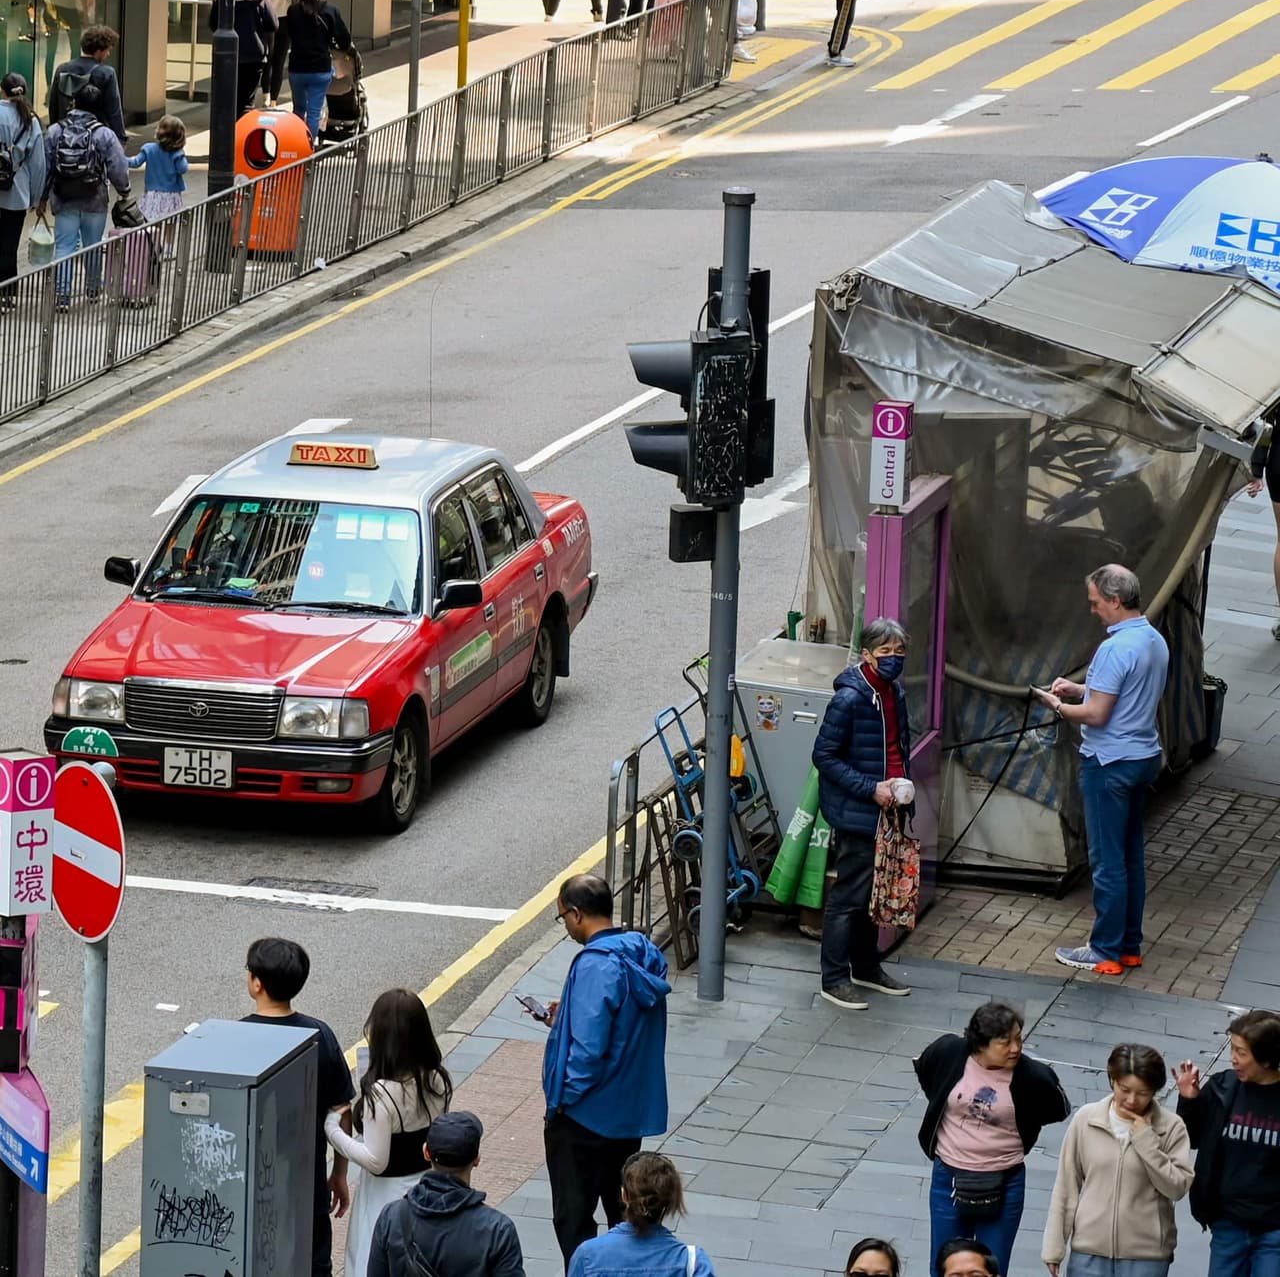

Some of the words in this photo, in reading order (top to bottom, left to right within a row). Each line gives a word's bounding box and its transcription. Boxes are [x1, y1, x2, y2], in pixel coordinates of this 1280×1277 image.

[297, 445, 367, 464] TAXI
[881, 445, 896, 499] Central
[73, 745, 107, 755] SEATS
[83, 735, 95, 746] 4
[184, 750, 212, 768] TH
[169, 765, 227, 787] 7502
[14, 820, 48, 903] 中環
